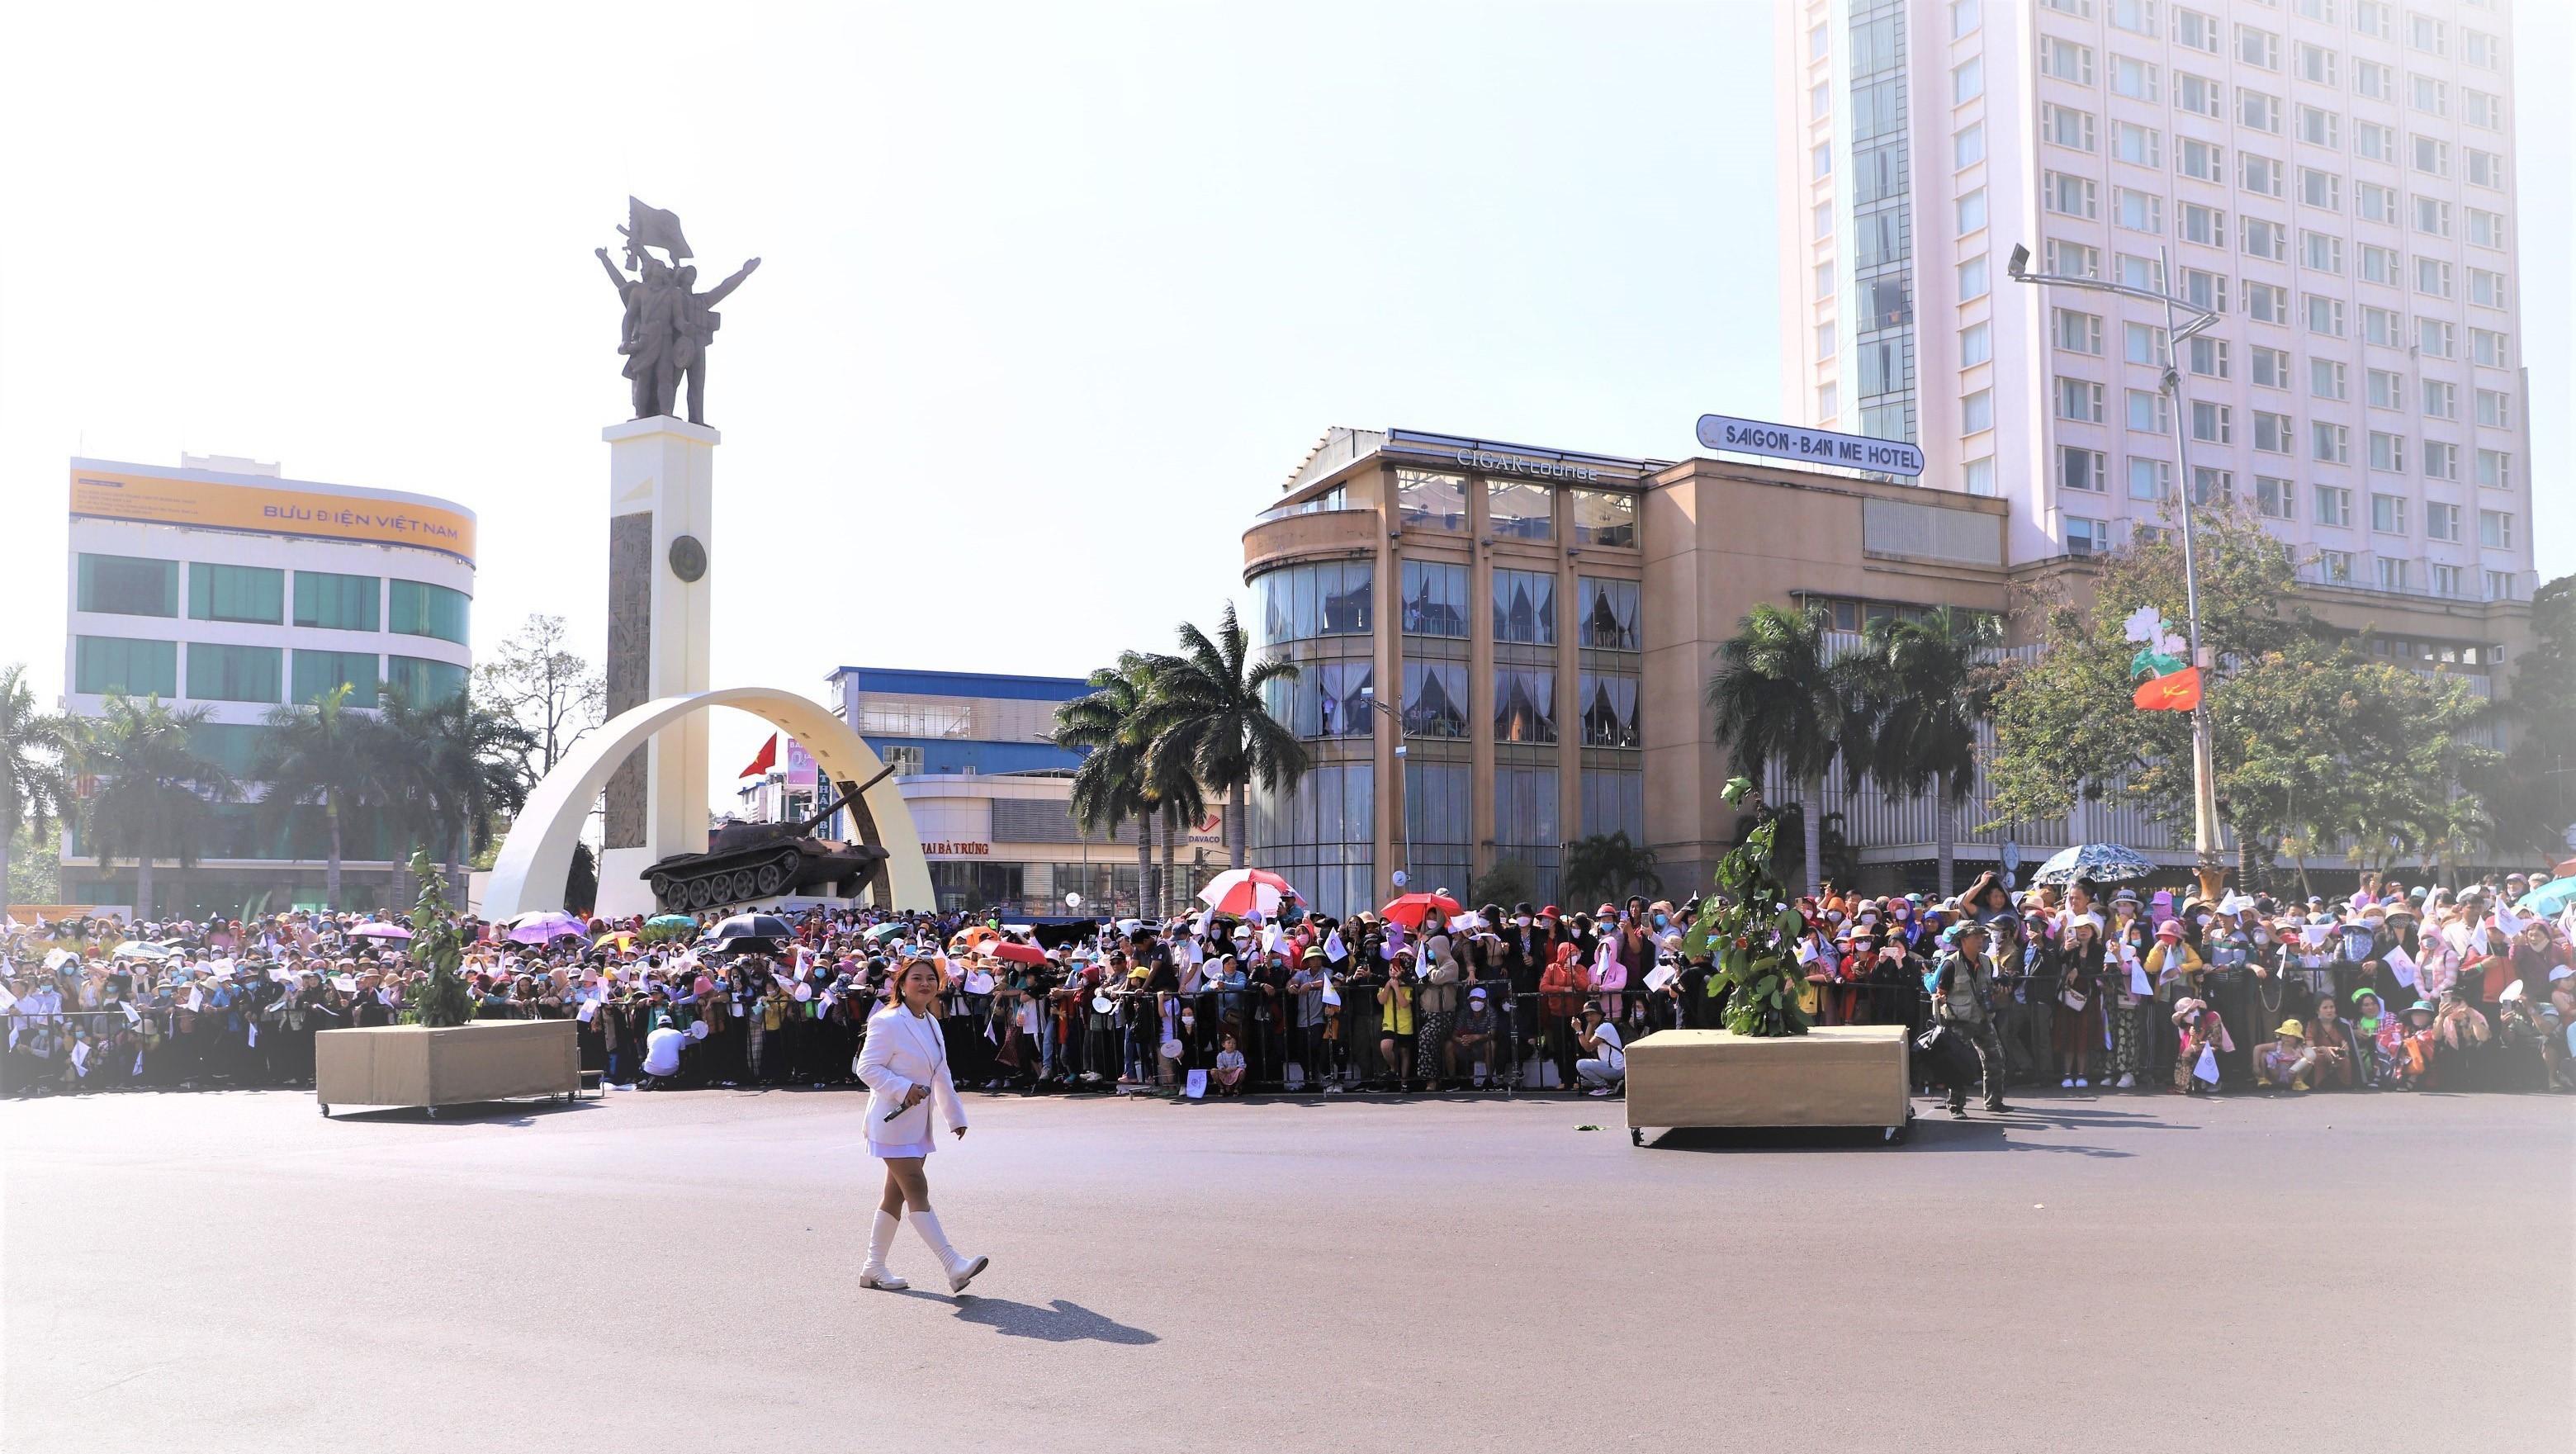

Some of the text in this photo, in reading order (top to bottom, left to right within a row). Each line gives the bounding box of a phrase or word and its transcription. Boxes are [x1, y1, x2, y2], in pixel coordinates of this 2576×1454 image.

[1456, 448, 1523, 472] CIGAR
[1726, 424, 1789, 451] SAIGON
[1801, 436, 1833, 457] BAN
[1840, 441, 1863, 462] ME
[1868, 445, 1920, 469] HOTEL
[264, 504, 457, 540] BƯU ĐIỆN VIỆT NAM
[953, 841, 989, 855] TRƯNG
